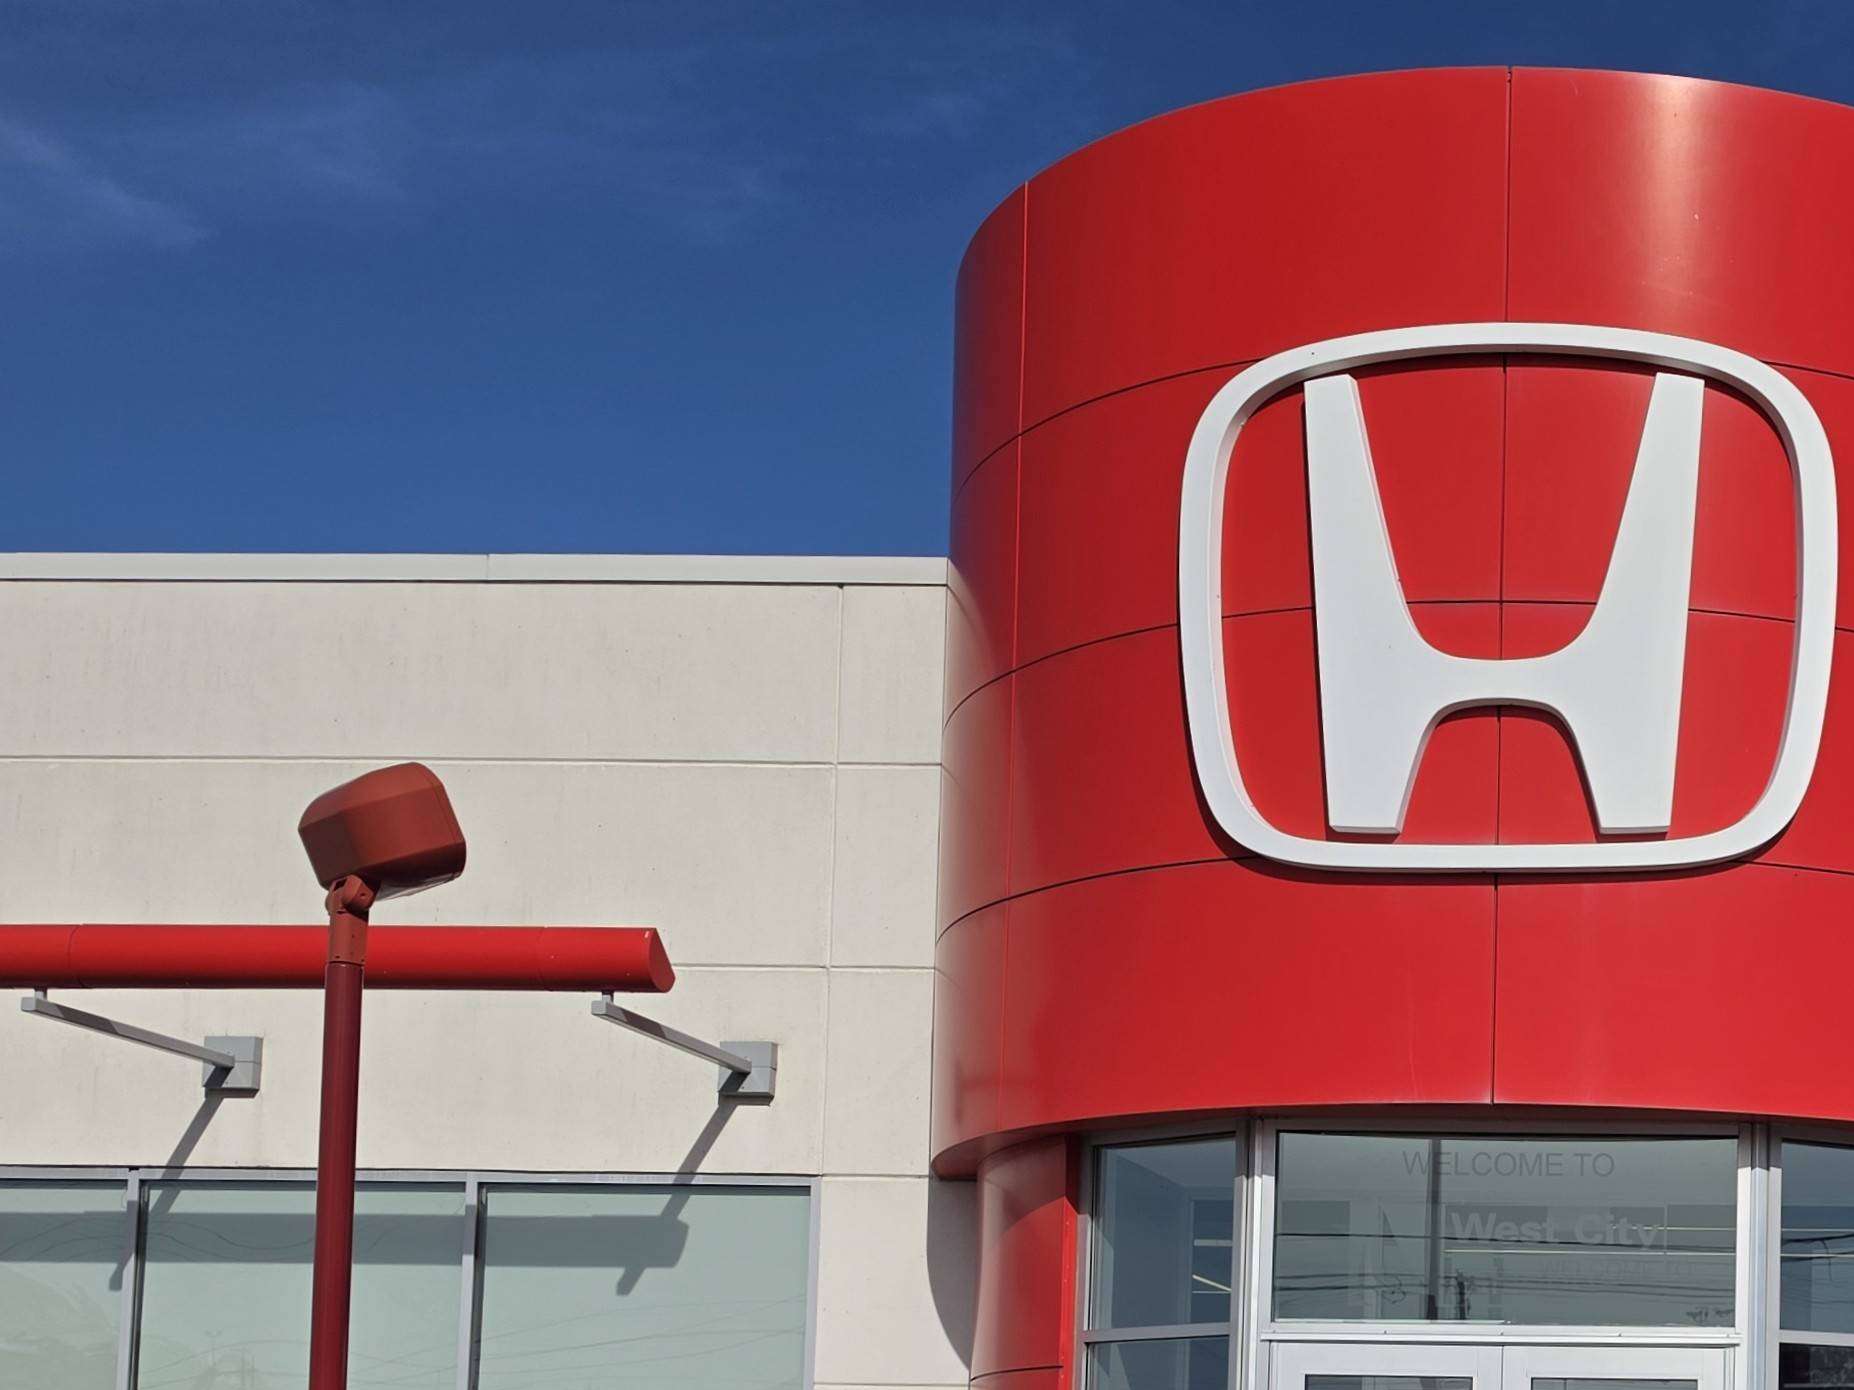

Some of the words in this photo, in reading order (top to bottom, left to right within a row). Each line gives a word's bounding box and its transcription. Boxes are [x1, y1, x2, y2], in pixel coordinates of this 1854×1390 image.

[1402, 1151, 1563, 1177] WELCOME
[1574, 1152, 1616, 1178] TO
[1451, 1212, 1559, 1244] West
[1574, 1212, 1661, 1251] City
